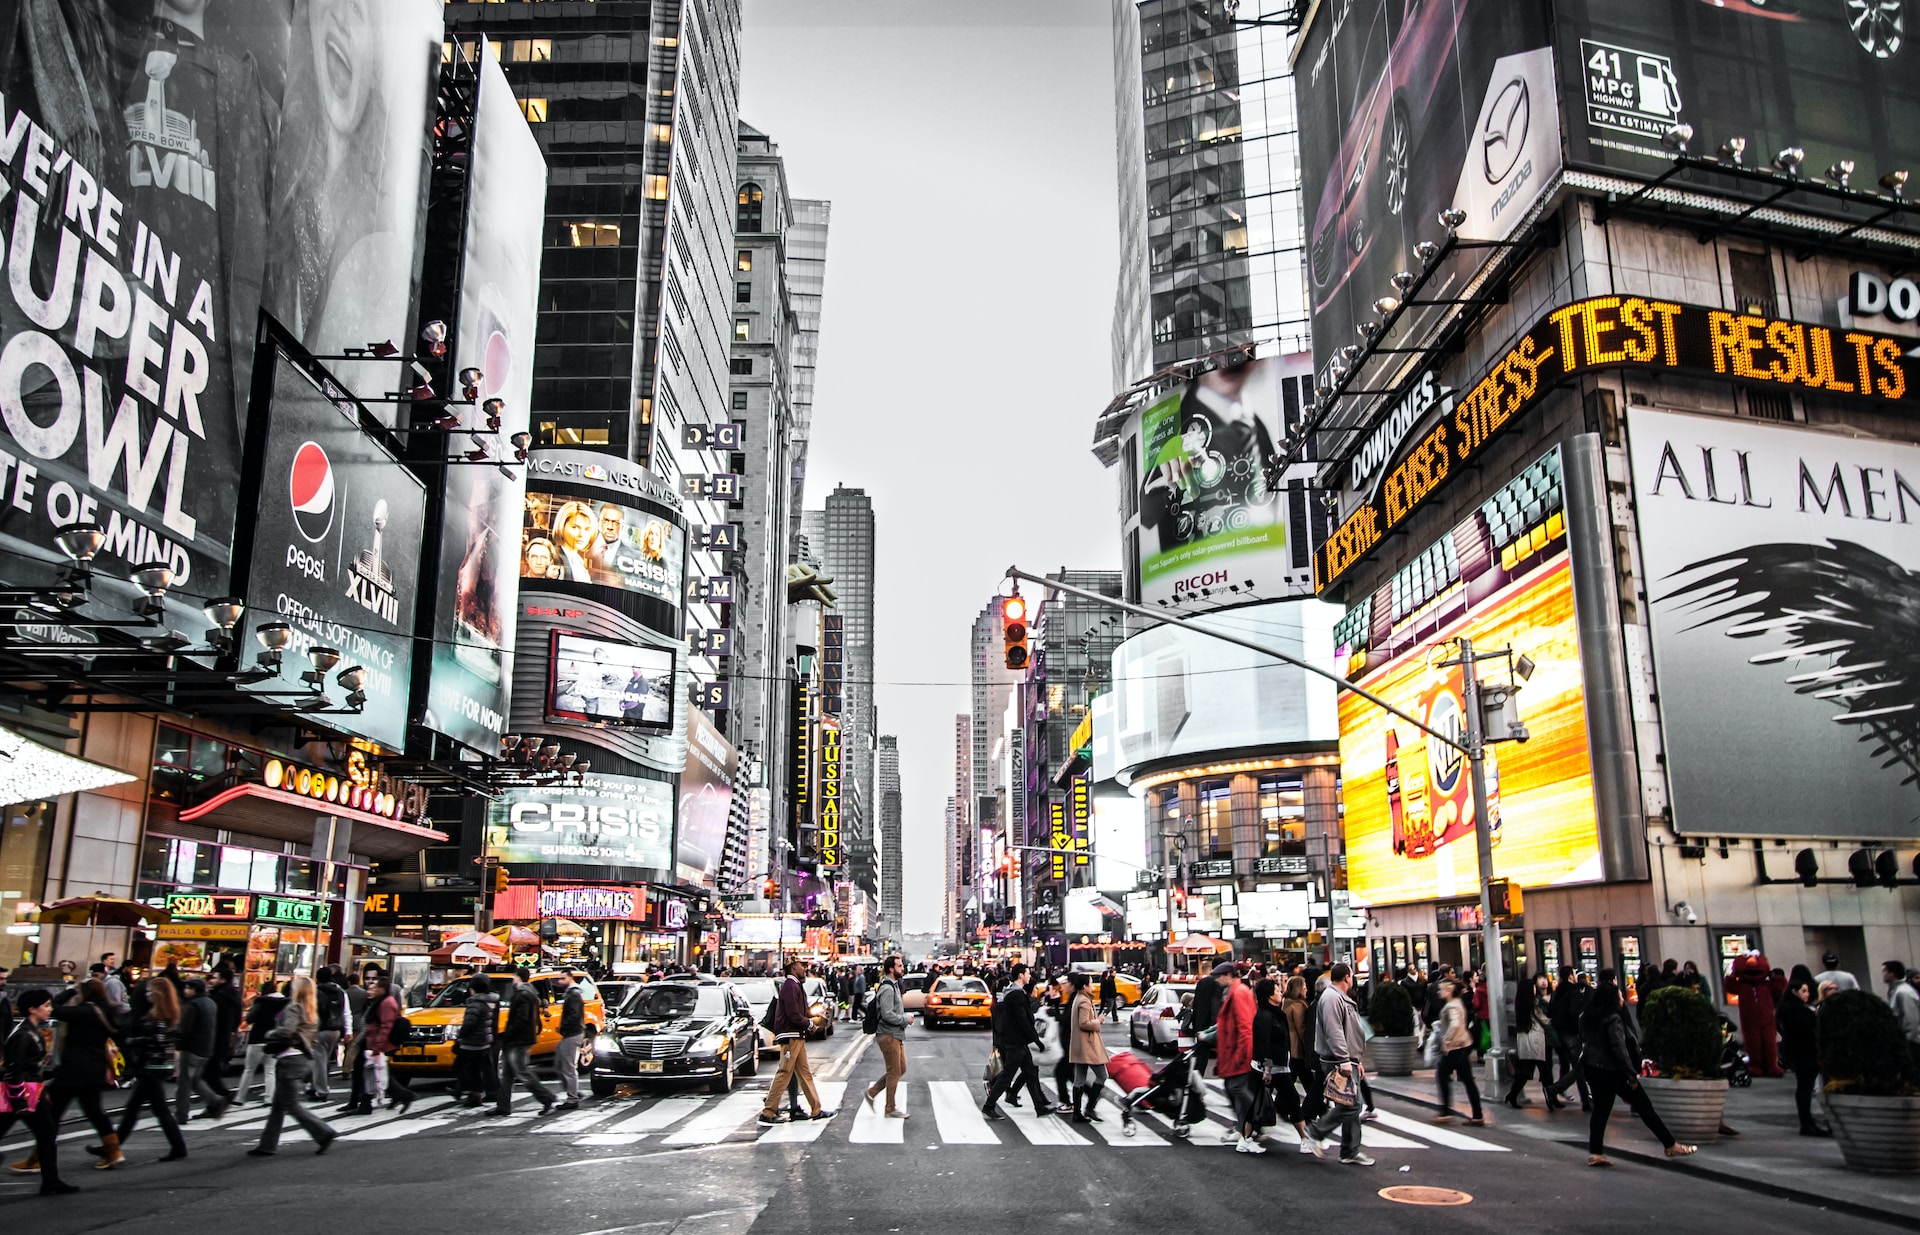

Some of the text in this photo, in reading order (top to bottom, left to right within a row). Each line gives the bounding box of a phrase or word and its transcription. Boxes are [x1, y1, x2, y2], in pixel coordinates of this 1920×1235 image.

[1588, 49, 1621, 80] 41
[1593, 93, 1634, 108] HIGHWAY
[1595, 111, 1616, 124] EPA
[160, 136, 190, 151] BOWL
[1491, 159, 1532, 222] mazda
[132, 220, 181, 308] IN
[187, 279, 215, 342] A
[1163, 415, 1175, 426] one
[1384, 423, 1450, 528] REVISES
[1708, 310, 1907, 399] RESULTS
[1647, 439, 1772, 509] ALL
[104, 509, 191, 587] MIND
[286, 544, 325, 582] pepsi
[1179, 550, 1192, 561] only
[617, 555, 678, 588] CRISIS
[1174, 569, 1228, 594] RICOH
[345, 568, 399, 626] XLVIII
[527, 605, 585, 618] SHARP
[276, 593, 395, 672] OFFICIAL SOFT DRINK OF
[461, 696, 480, 723] FOR
[481, 706, 504, 734] NOW
[529, 787, 574, 797] protect
[577, 788, 597, 797] the
[599, 789, 625, 800] ones
[603, 781, 623, 791] you
[624, 783, 636, 793] go
[823, 730, 839, 865] TUSSAUD'S
[1074, 777, 1088, 832] VICTORY
[510, 802, 660, 842] CRISIS
[541, 844, 599, 858] SUNDAYS
[276, 901, 314, 921] RICE
[541, 888, 635, 916] CHAMPS
[159, 928, 247, 937] HALAL FOOD
